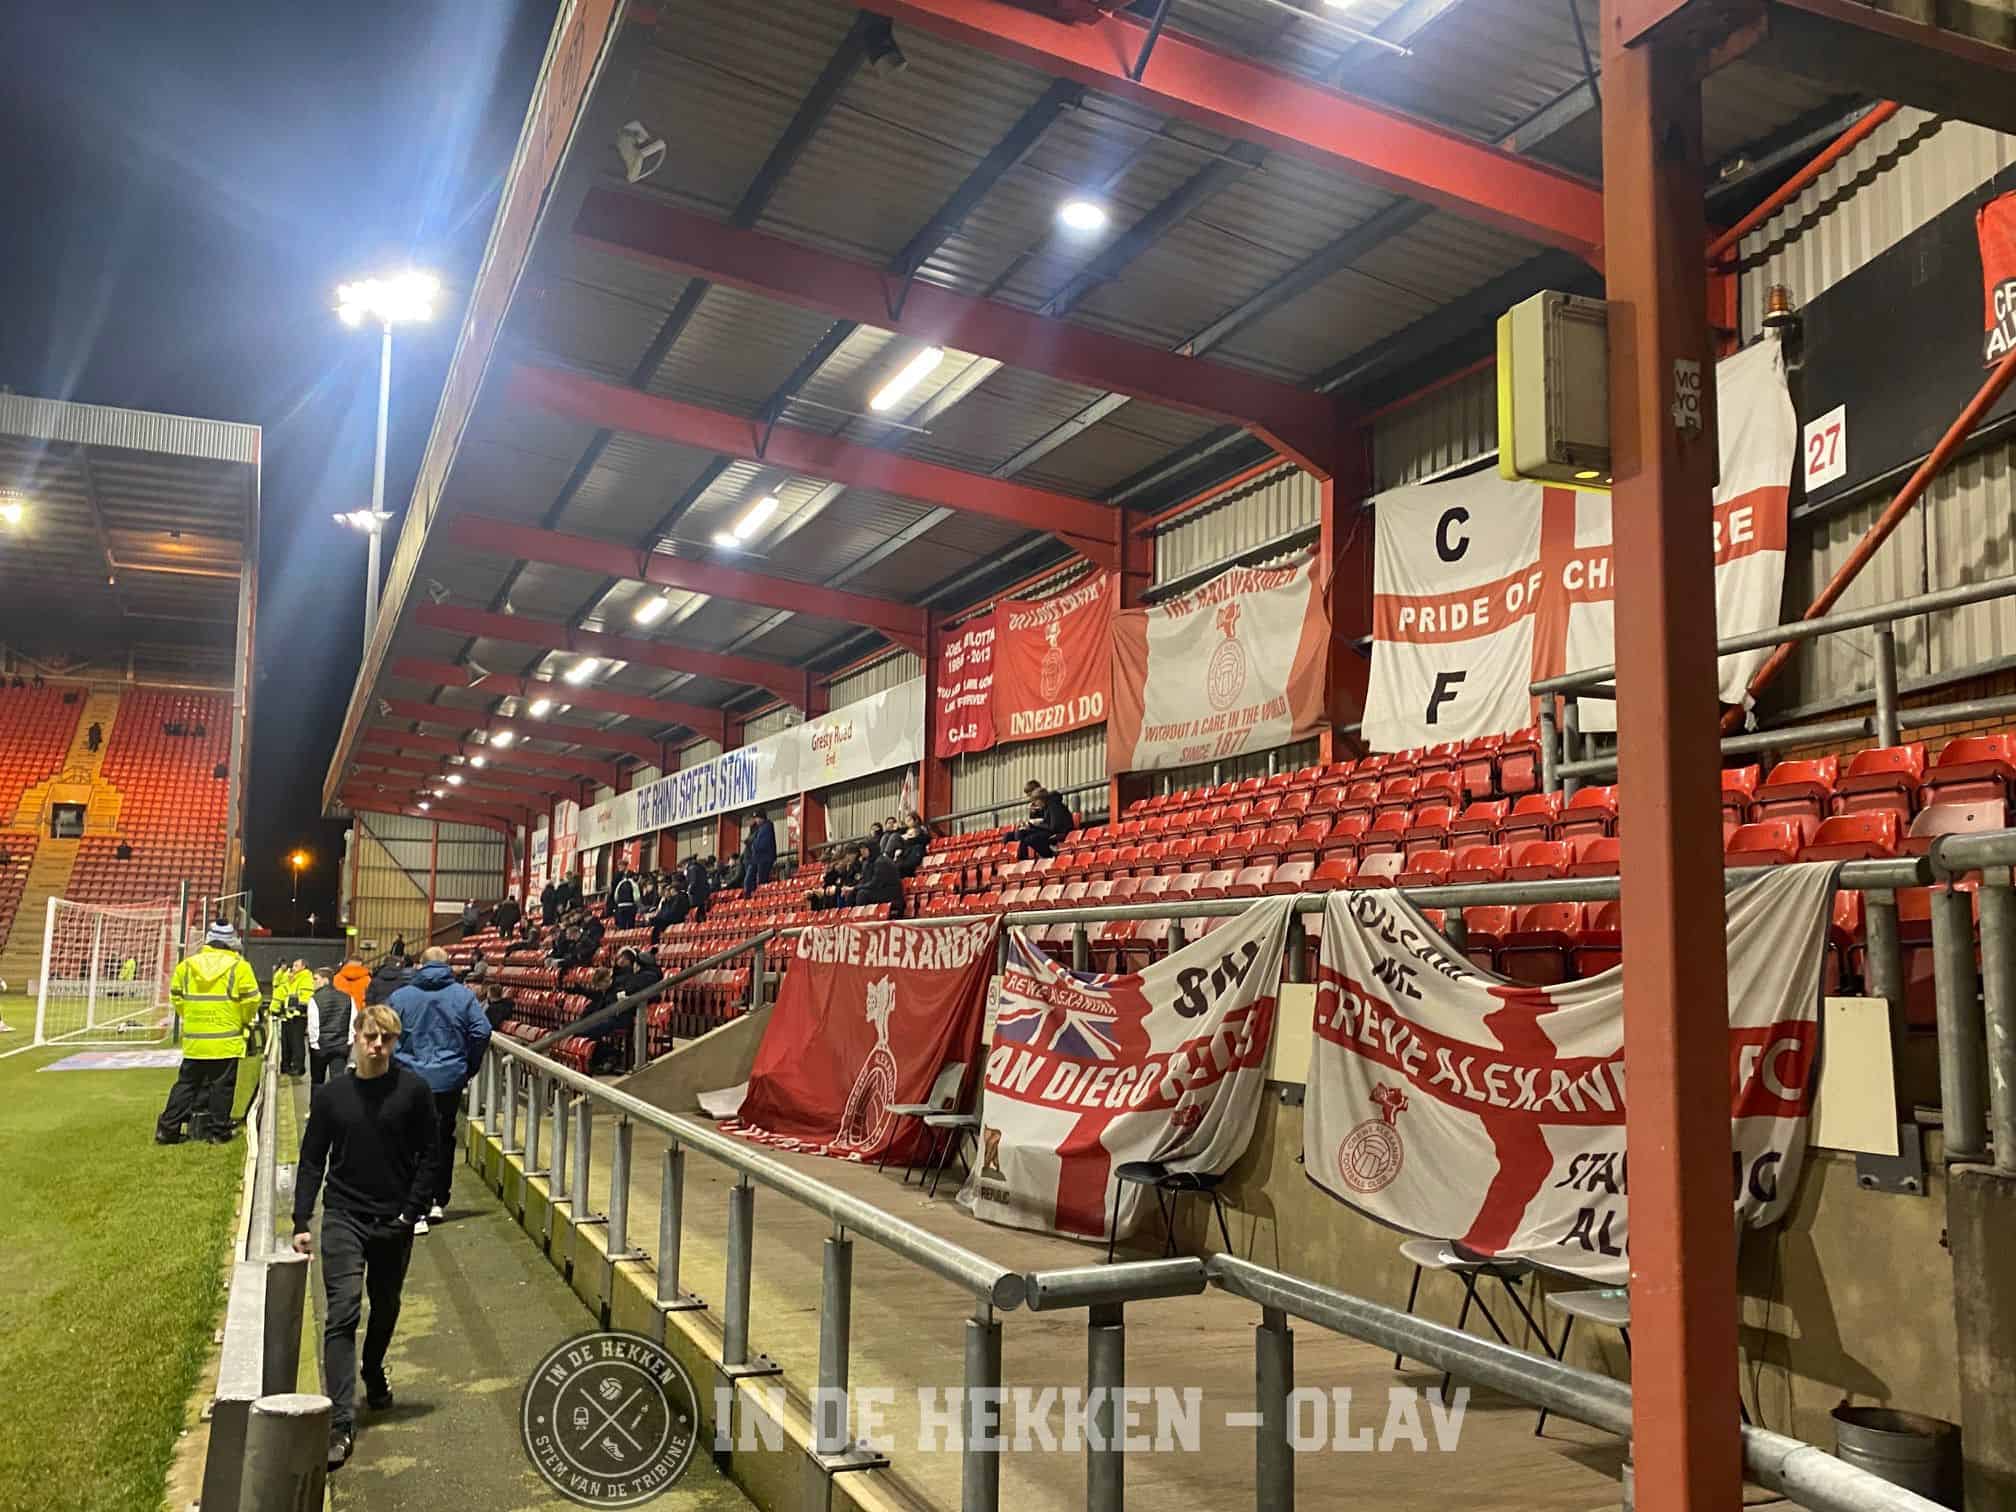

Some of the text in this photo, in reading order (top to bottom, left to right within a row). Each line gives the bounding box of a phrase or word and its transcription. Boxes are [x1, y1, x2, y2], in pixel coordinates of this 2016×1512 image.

[1808, 423, 1841, 475] 27
[1435, 506, 1470, 562] C
[1399, 597, 1490, 633] PRIDE
[1506, 571, 1544, 612] OF
[1010, 691, 1103, 736] INDEED I DO
[1145, 696, 1287, 742] WITHOUT A CARE IN THE WORLD
[1426, 671, 1467, 725] F
[1214, 728, 1252, 757] 1877
[637, 787, 651, 832] THE
[652, 777, 678, 826] RHINO
[680, 759, 718, 819] SAFETY
[719, 747, 758, 808] STAND
[796, 925, 861, 965] CREWE
[1040, 1062, 1162, 1108] DIEGO
[1430, 1047, 1625, 1113] ALEXAN
[1739, 1037, 1803, 1101] FC
